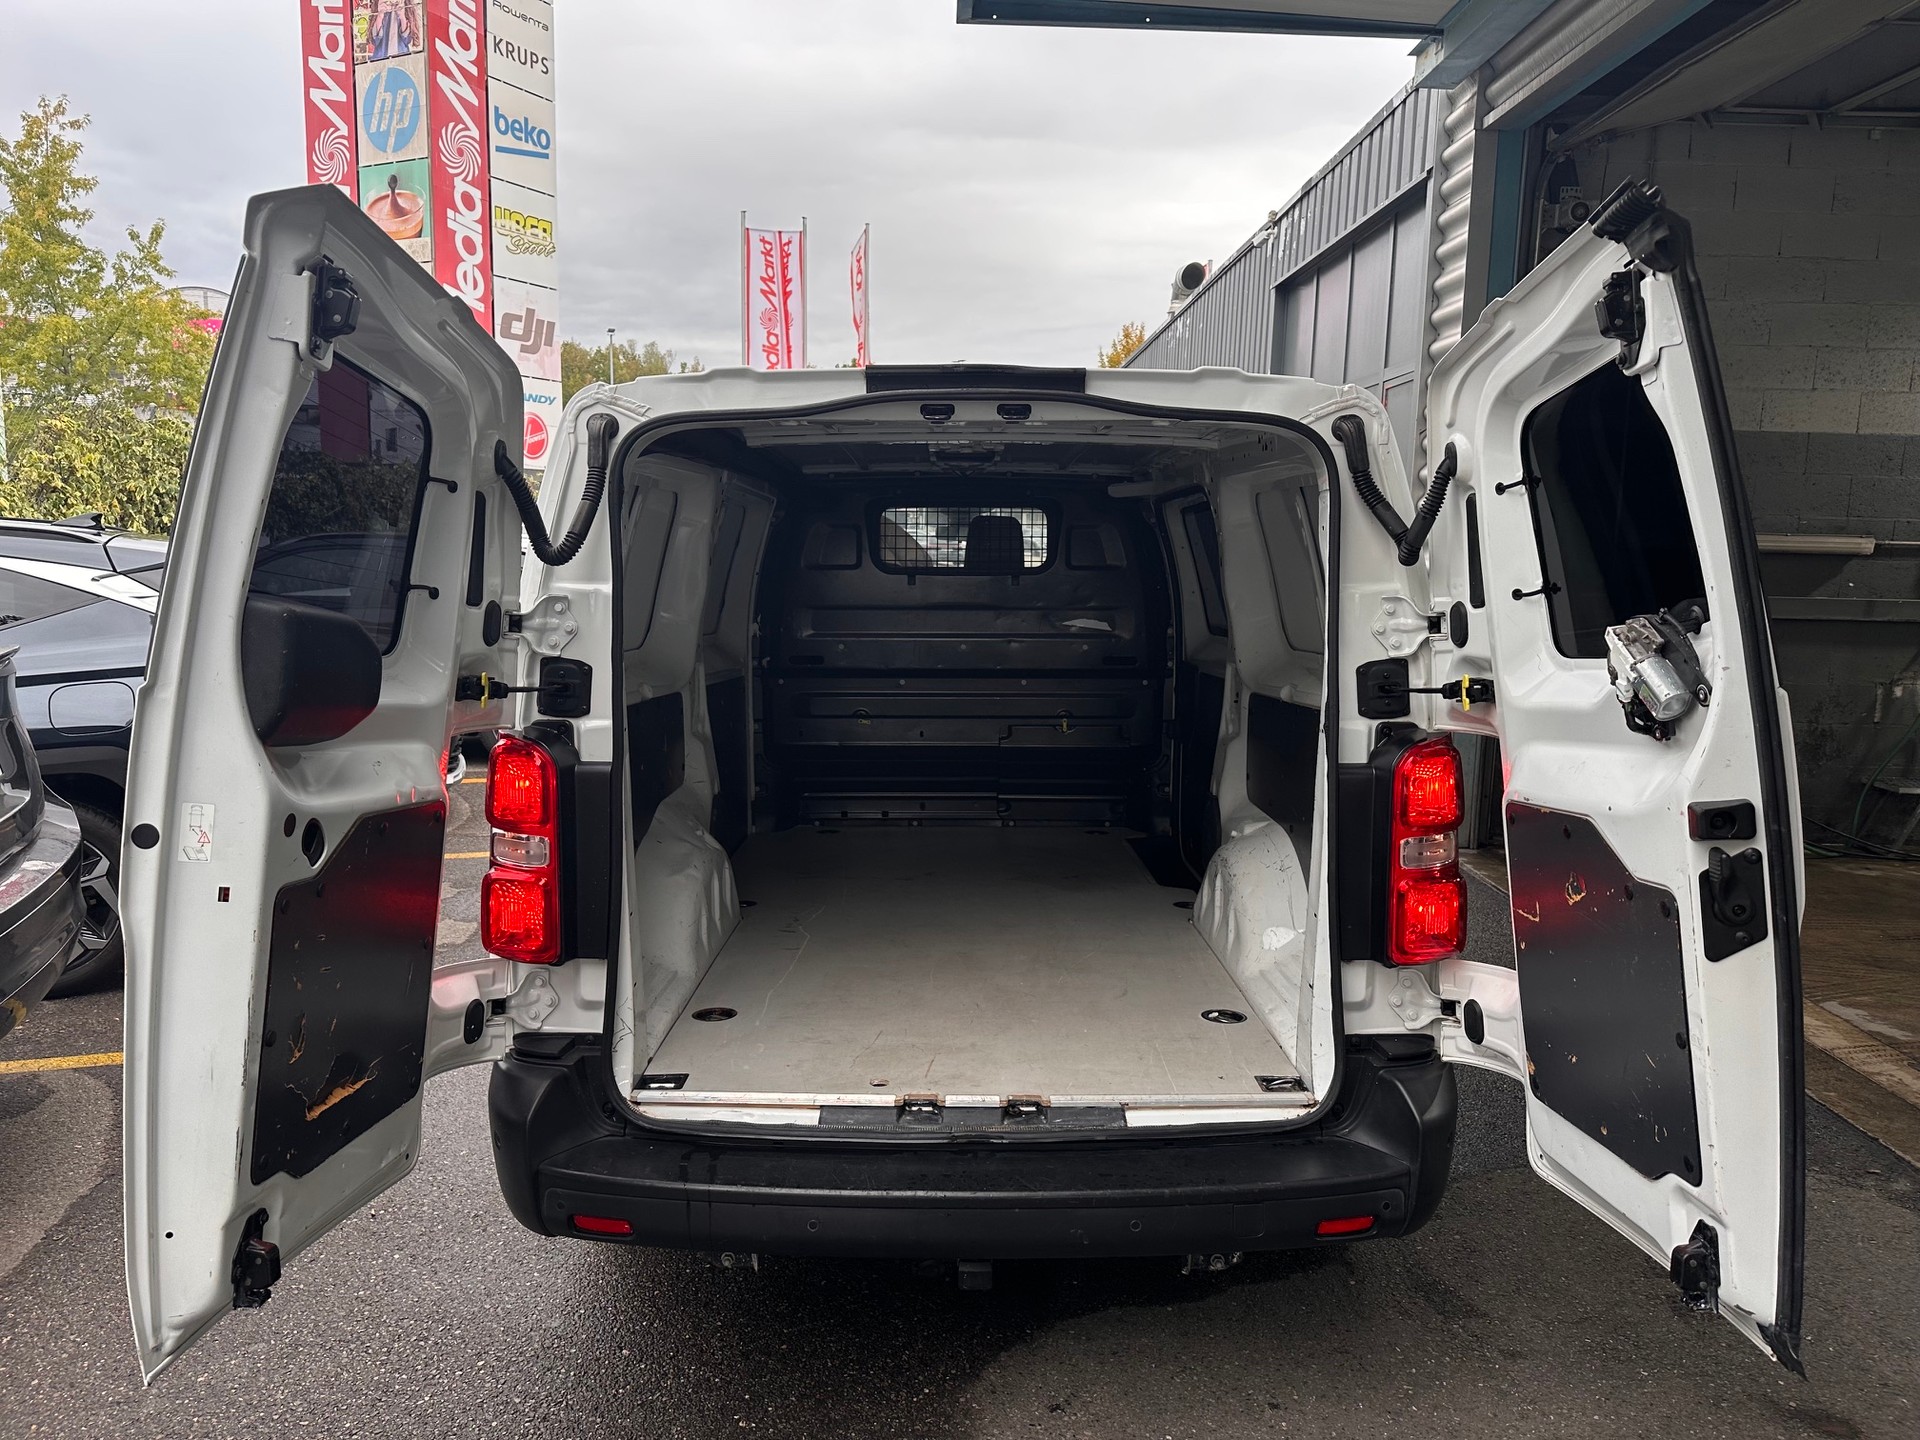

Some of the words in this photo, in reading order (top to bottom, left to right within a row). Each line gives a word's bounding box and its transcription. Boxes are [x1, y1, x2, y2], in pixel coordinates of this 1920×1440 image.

[493, 0, 549, 32] Rowenta
[493, 35, 549, 75] KRUPS
[369, 66, 415, 154] hp
[494, 105, 551, 150] beko
